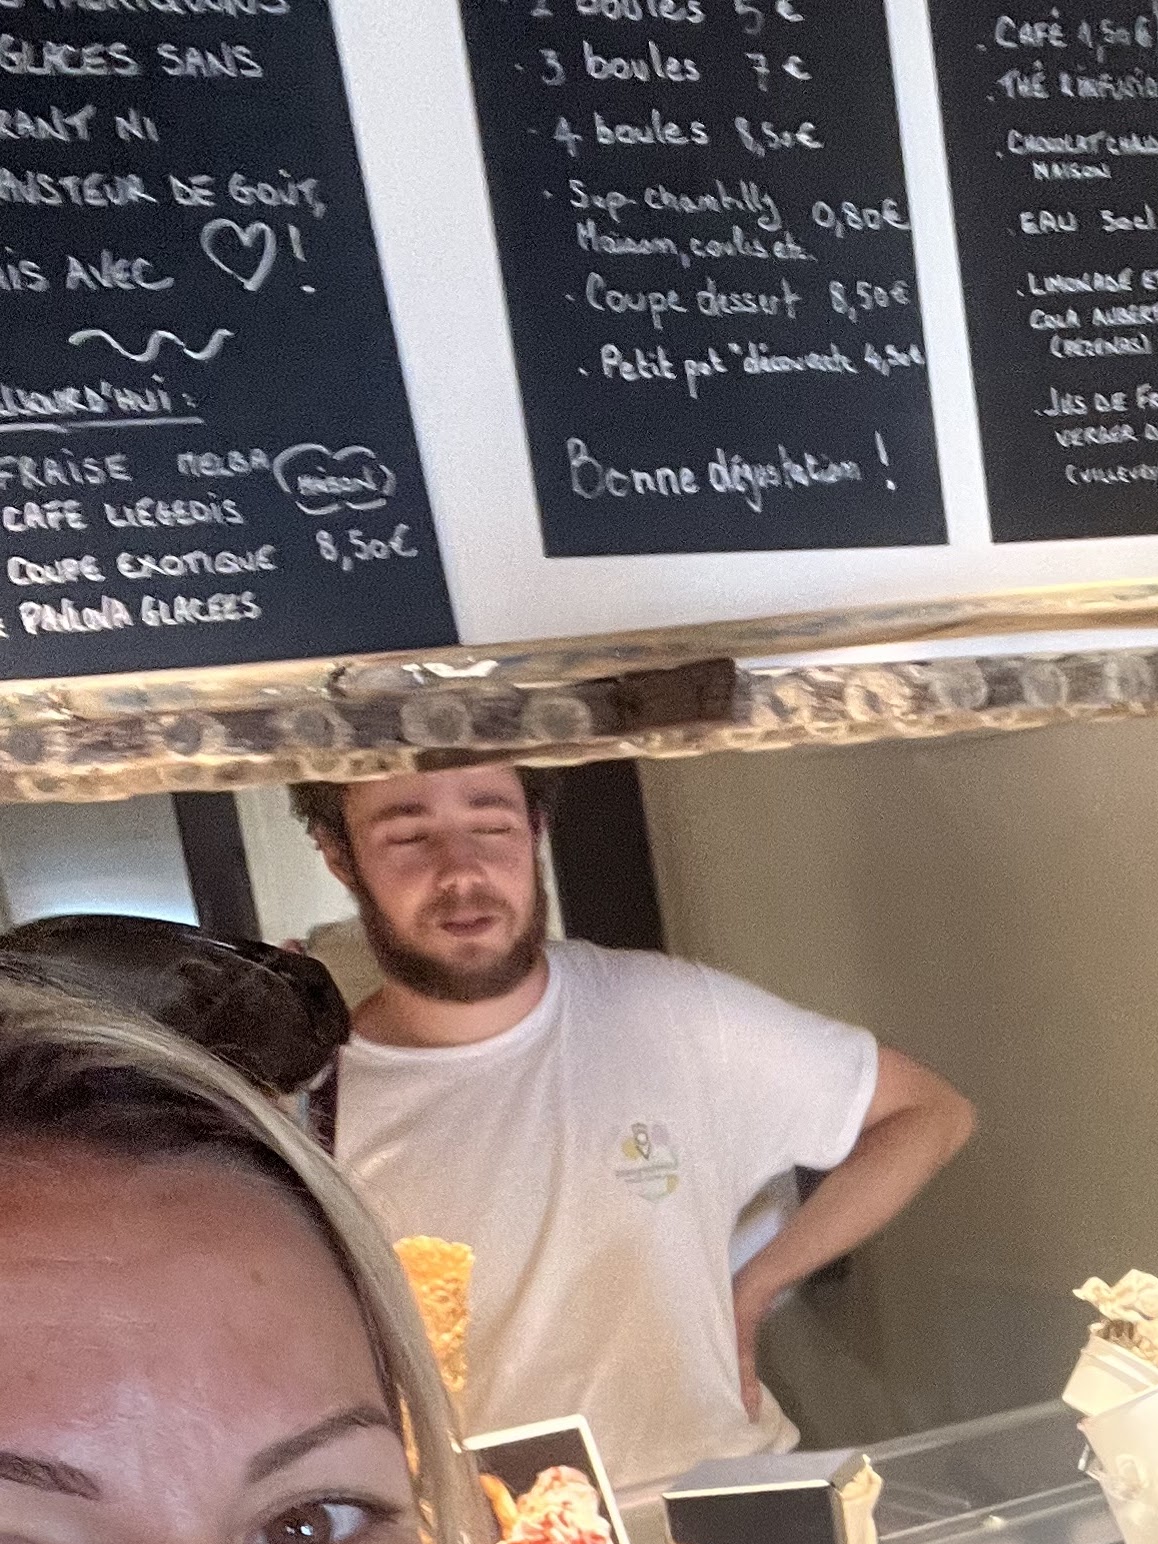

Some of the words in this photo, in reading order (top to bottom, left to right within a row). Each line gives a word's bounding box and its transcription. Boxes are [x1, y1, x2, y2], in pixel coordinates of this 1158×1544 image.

[995, 6, 1068, 48] CAFÉ
[157, 41, 263, 78] SANS
[540, 49, 565, 86] 3
[583, 40, 700, 82] boules
[115, 107, 160, 143] NI
[554, 117, 582, 157] 4
[595, 109, 709, 146] boules
[169, 174, 216, 207] DE
[812, 199, 911, 239] 0,80€
[1020, 211, 1078, 235] EAU
[65, 250, 175, 293] AVEC
[586, 272, 688, 330] Coupe
[829, 280, 912, 324] 8,50€
[1094, 391, 1129, 412] DE
[0, 448, 132, 491] FRAISE
[567, 437, 700, 500] Bonne
[7, 555, 106, 585] COUPE
[116, 544, 278, 579] EXOTIQUE
[316, 523, 418, 571] 8,50€
